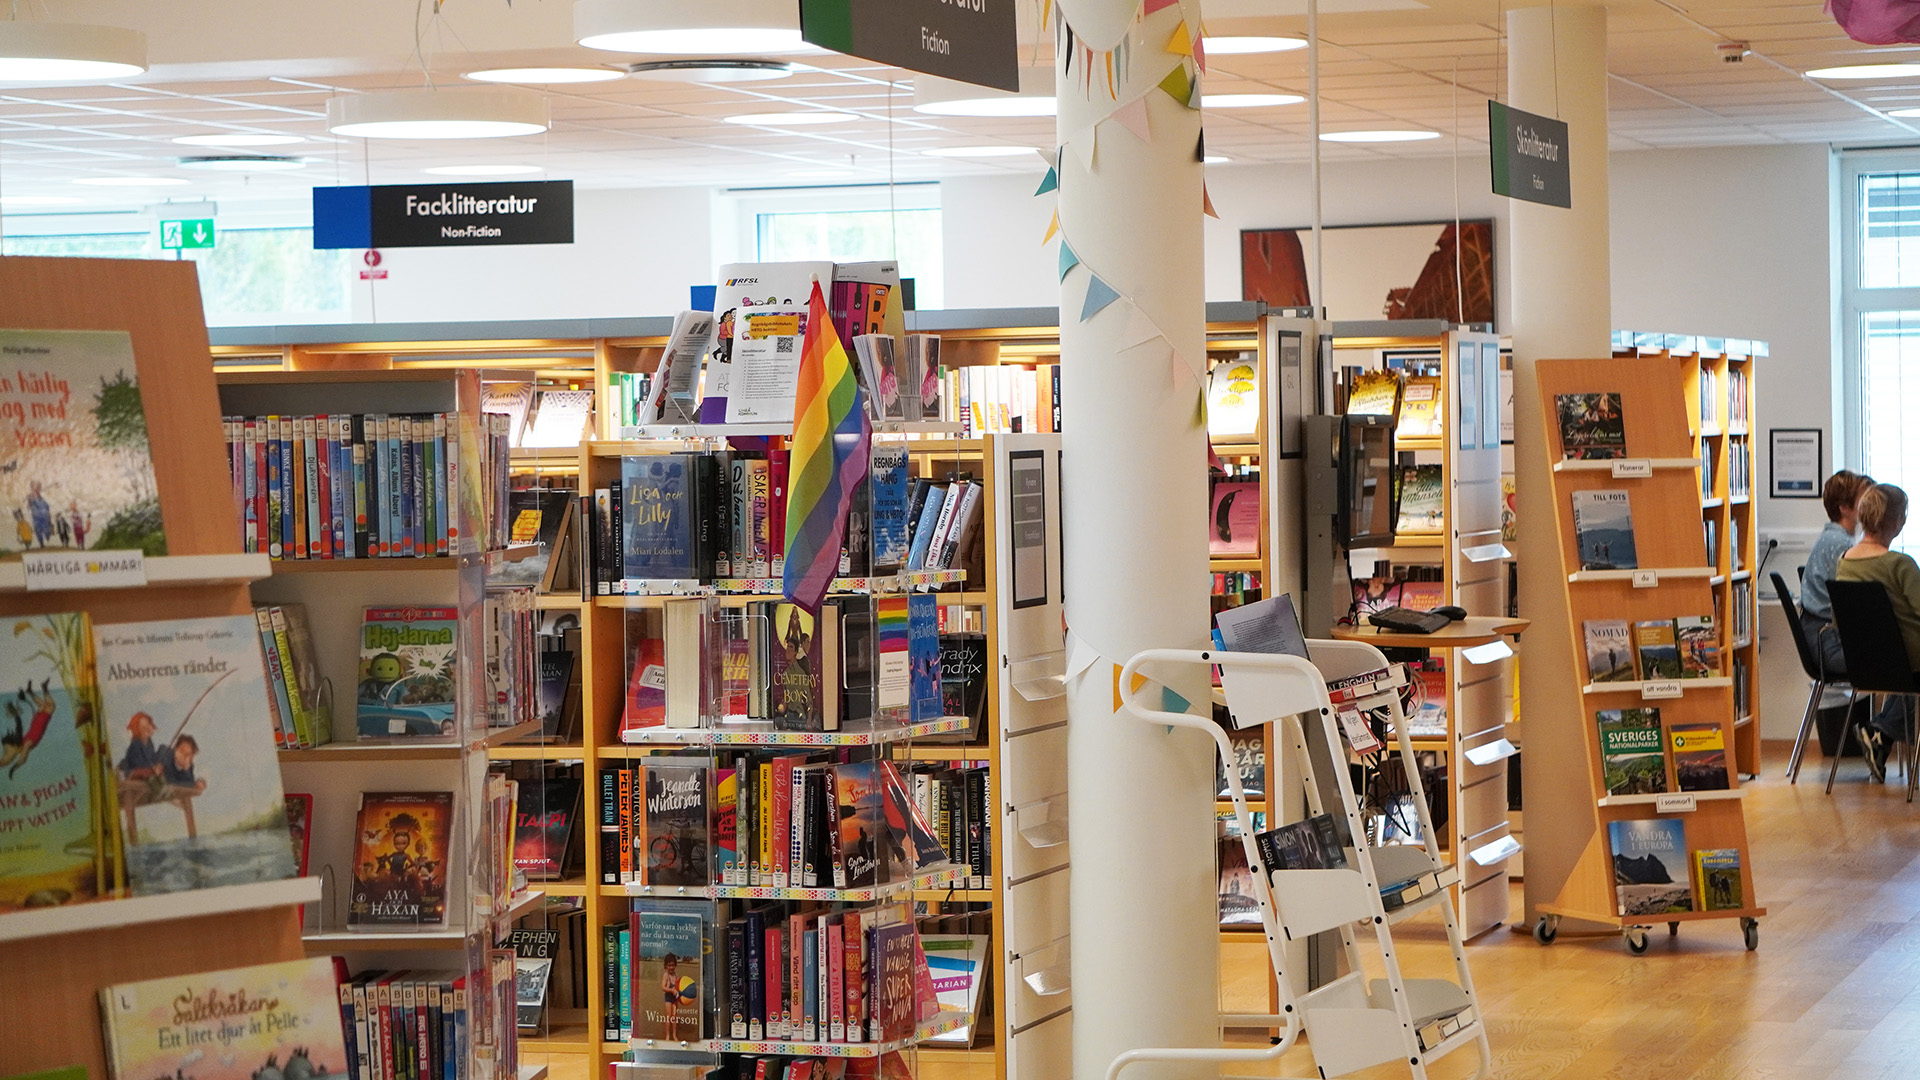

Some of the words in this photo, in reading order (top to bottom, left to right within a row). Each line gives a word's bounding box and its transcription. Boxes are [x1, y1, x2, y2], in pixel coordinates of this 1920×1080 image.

[921, 26, 950, 55] Fiction
[1516, 125, 1559, 162] Skönlitteratur
[405, 194, 538, 217] Facklitteratur
[441, 225, 502, 239] Non-Fiction
[630, 483, 660, 505] Lisa
[754, 474, 767, 509] SAKER
[947, 493, 955, 508] Nick
[639, 502, 672, 531] Lilly
[939, 508, 950, 530] Hornby
[754, 510, 767, 546] INGEN
[631, 546, 652, 555] Mian
[653, 546, 684, 556] Lodalen
[364, 623, 453, 652] Höjdarna
[1591, 627, 1629, 638] NOMAD
[107, 660, 181, 681] Abborrens
[183, 655, 229, 676] ränder
[941, 660, 983, 675] ndrix
[773, 671, 818, 688] CEMETERY
[1338, 673, 1376, 688] ENGMAN
[1656, 684, 1678, 692] vandra
[783, 688, 808, 704] BOYS
[1607, 729, 1659, 744] SVERIGES
[1609, 740, 1660, 750] NATIONALPARKER
[603, 774, 613, 801] BULLET
[620, 772, 629, 811] PETER
[660, 771, 701, 798] Jeanette
[604, 801, 614, 823] TRAIN
[647, 792, 702, 815] Winterson
[517, 812, 568, 828] TALPI
[621, 813, 629, 854] JAMES
[1274, 829, 1297, 850] SIMON
[1628, 829, 1673, 841] VANDRA
[1261, 837, 1275, 866] SIMON
[1637, 840, 1674, 850] EUROPA
[971, 844, 981, 874] THUD!
[384, 889, 409, 900] AYA
[505, 931, 557, 944] TEPHEN
[640, 920, 662, 931] Varför
[662, 922, 675, 931] vara
[676, 922, 697, 934] lycklig
[653, 930, 662, 939] du
[662, 930, 674, 939] kan
[675, 932, 689, 940] vara
[886, 952, 910, 972] VANLIG
[886, 972, 912, 1010] SUPER
[932, 979, 968, 990] RARIAN
[172, 987, 280, 1026] Saltkråkan
[832, 976, 840, 1016] TRIANGE
[645, 1009, 699, 1025] Winterson
[673, 1006, 699, 1015] Jeanette
[891, 994, 912, 1025] NOVA
[157, 1026, 181, 1050] Ett
[186, 1024, 213, 1046] litet
[216, 1021, 245, 1046] djur
[248, 1016, 263, 1034] åt
[266, 1012, 299, 1032] Pelle
[417, 1015, 426, 1032] BIG
[419, 1033, 427, 1059] HERO
